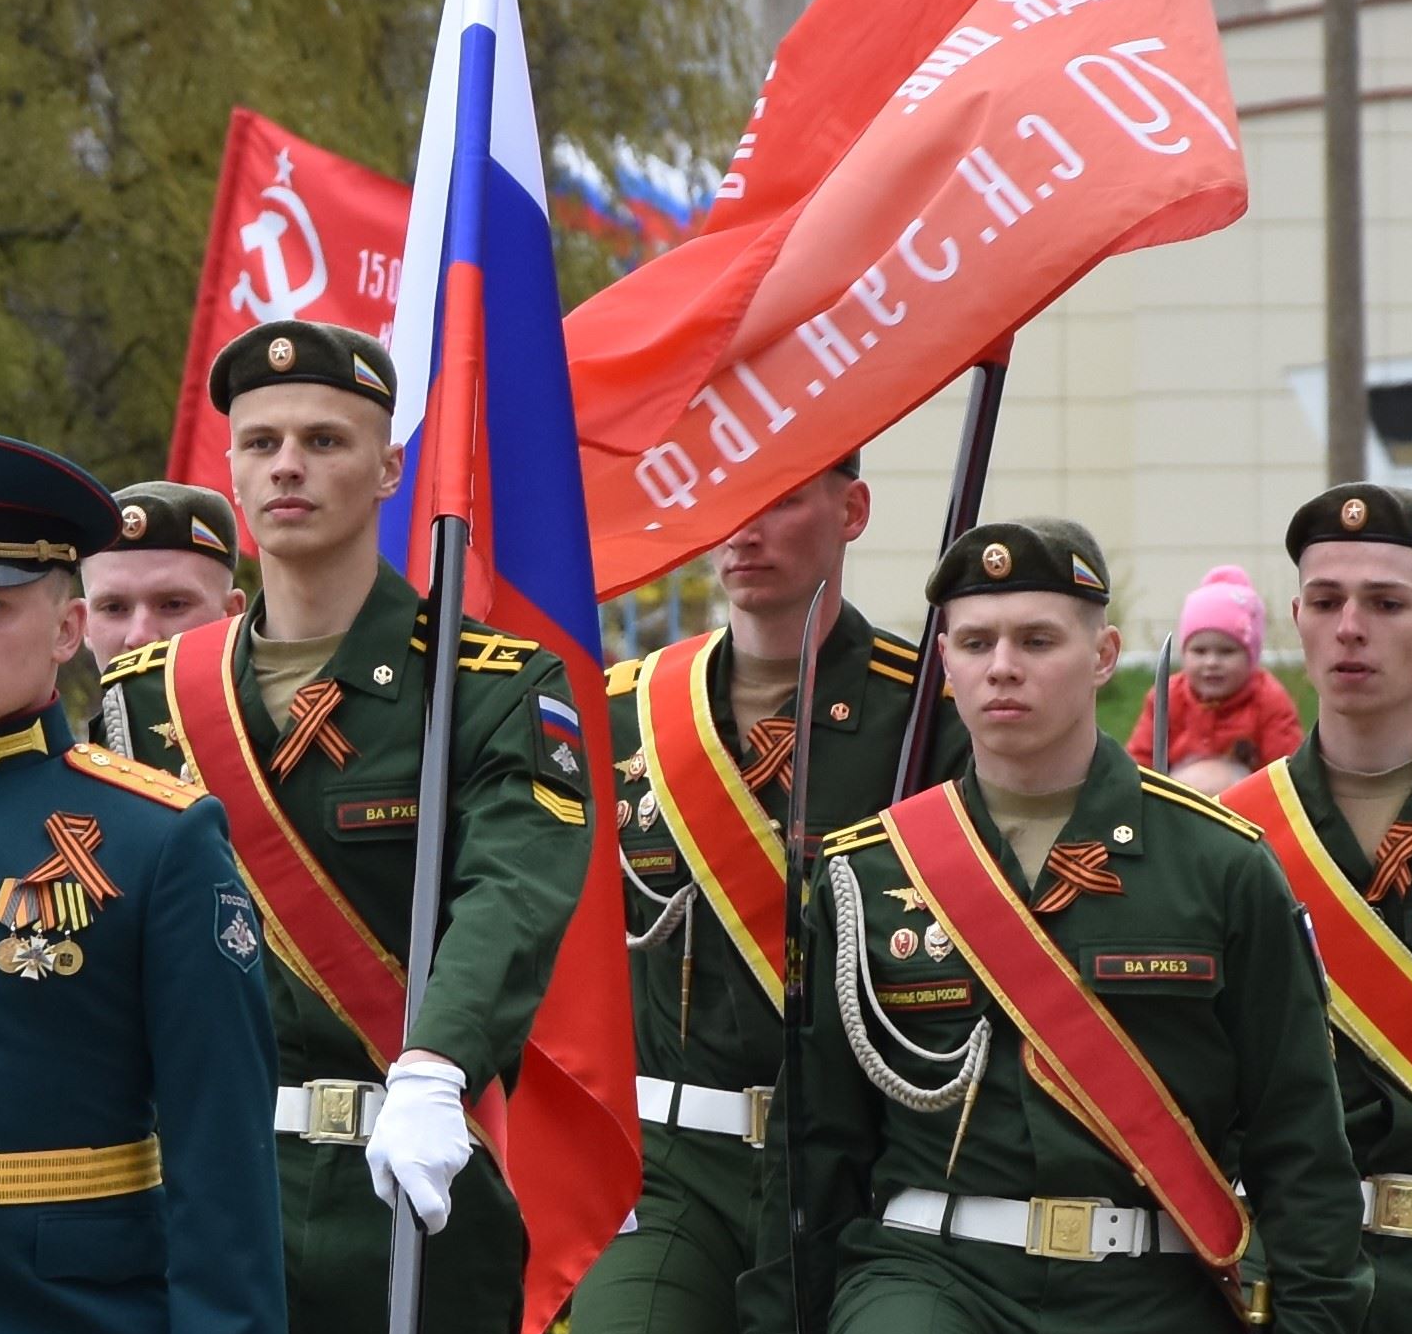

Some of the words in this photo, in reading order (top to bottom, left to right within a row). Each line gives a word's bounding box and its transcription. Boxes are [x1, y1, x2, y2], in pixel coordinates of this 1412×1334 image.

[357, 249, 403, 305] 150
[366, 808, 385, 820] ВА
[1124, 960, 1144, 973] ВА
[1150, 960, 1188, 973] РХБЗ
